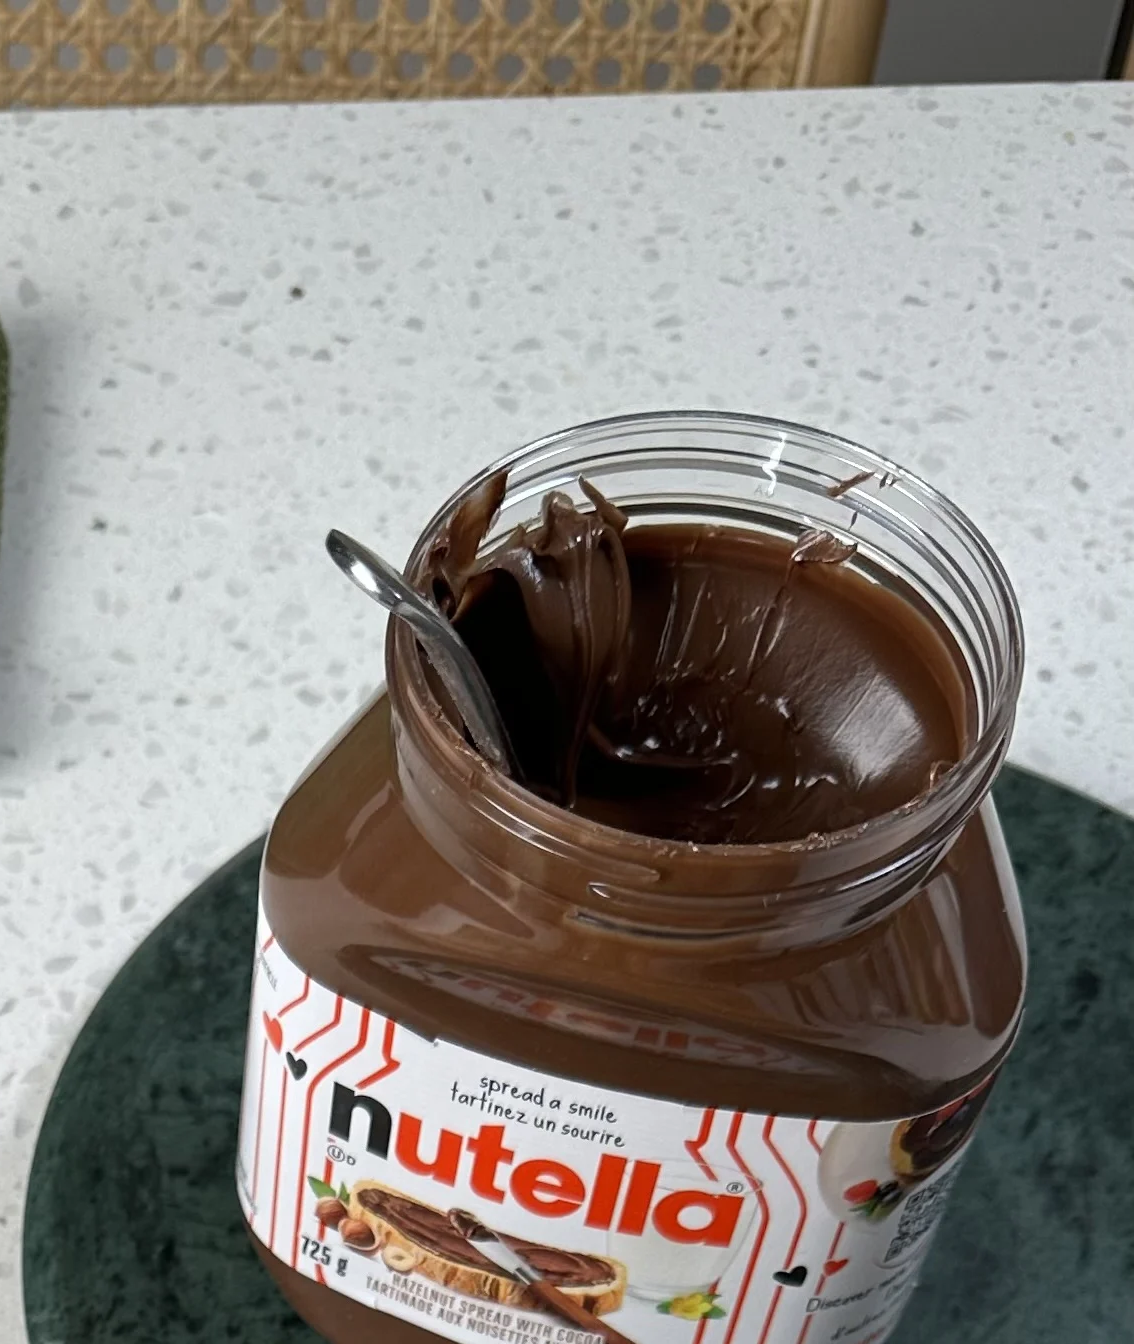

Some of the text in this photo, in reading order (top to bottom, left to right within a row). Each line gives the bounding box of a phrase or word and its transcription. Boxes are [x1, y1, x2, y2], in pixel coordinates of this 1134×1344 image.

[450, 1081, 626, 1148] tartinez un sourire
[479, 1076, 618, 1124] spread a smile
[328, 1081, 745, 1249] nutella
[301, 1235, 349, 1277] 725 g
[366, 1276, 434, 1316] TARTINADE
[437, 1307, 465, 1326] AUX
[392, 1273, 456, 1309] HAZELNUT
[458, 1300, 513, 1327] SPREAD
[516, 1316, 553, 1339] WITH
